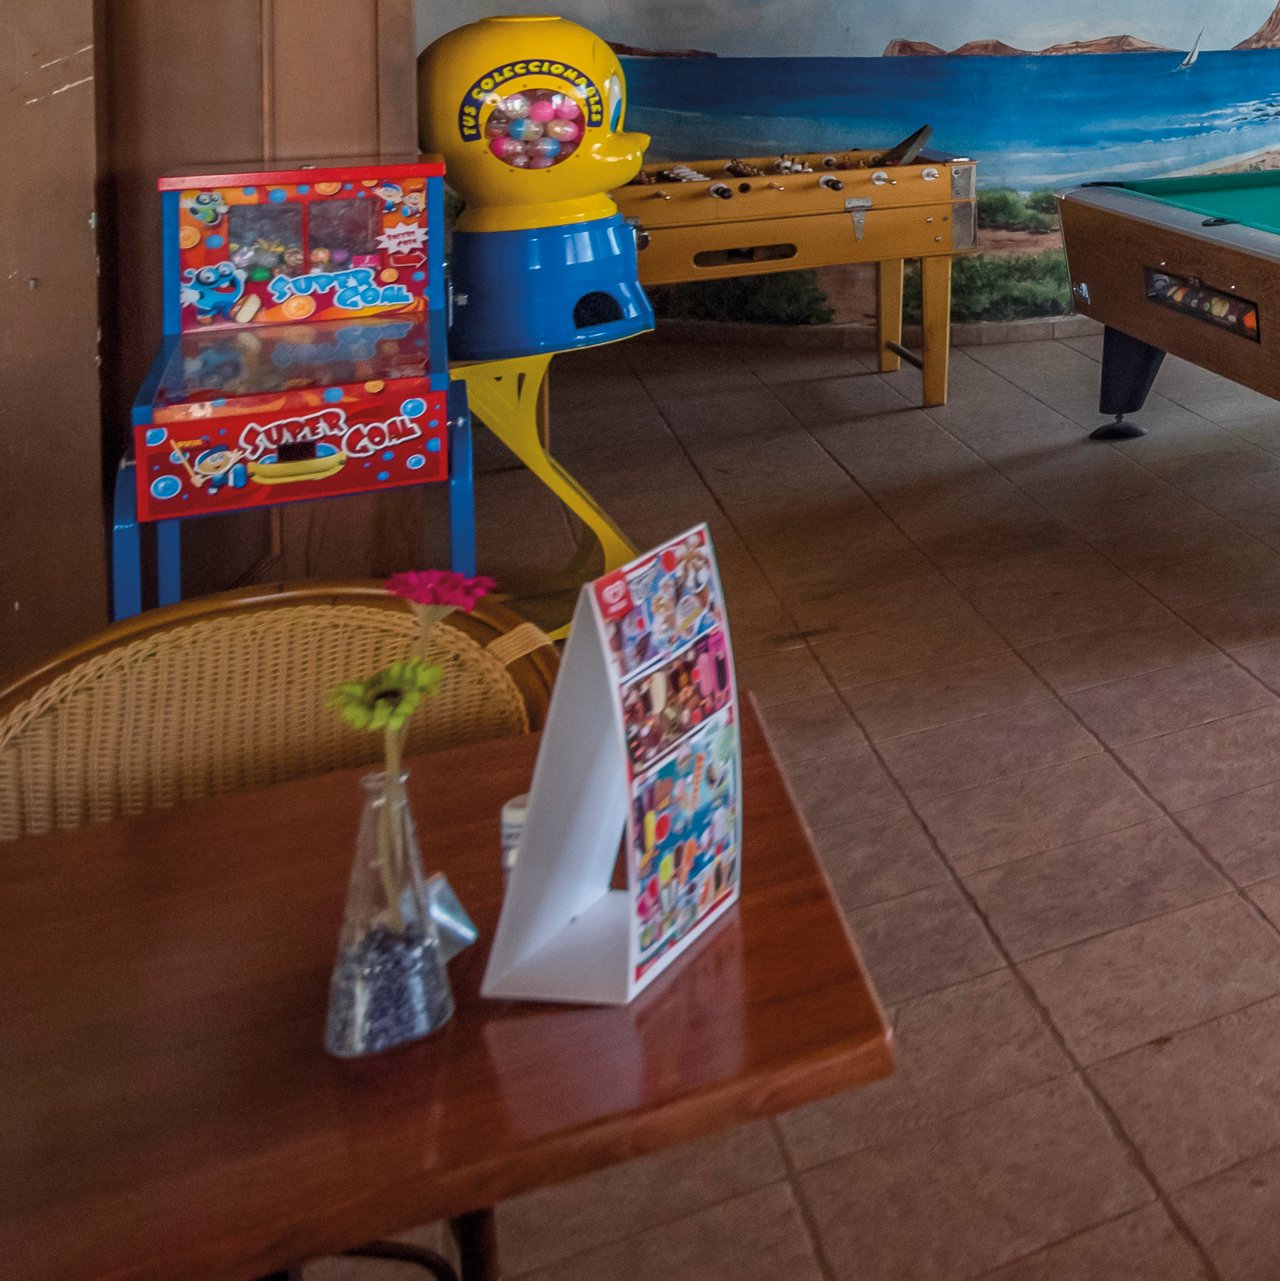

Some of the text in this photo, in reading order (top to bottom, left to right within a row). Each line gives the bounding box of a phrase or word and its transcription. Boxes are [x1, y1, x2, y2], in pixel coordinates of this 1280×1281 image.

[462, 105, 477, 136] TUS
[268, 268, 376, 303] SUPER
[334, 285, 415, 310] GOAL
[238, 408, 422, 460] SUPER GOAL
